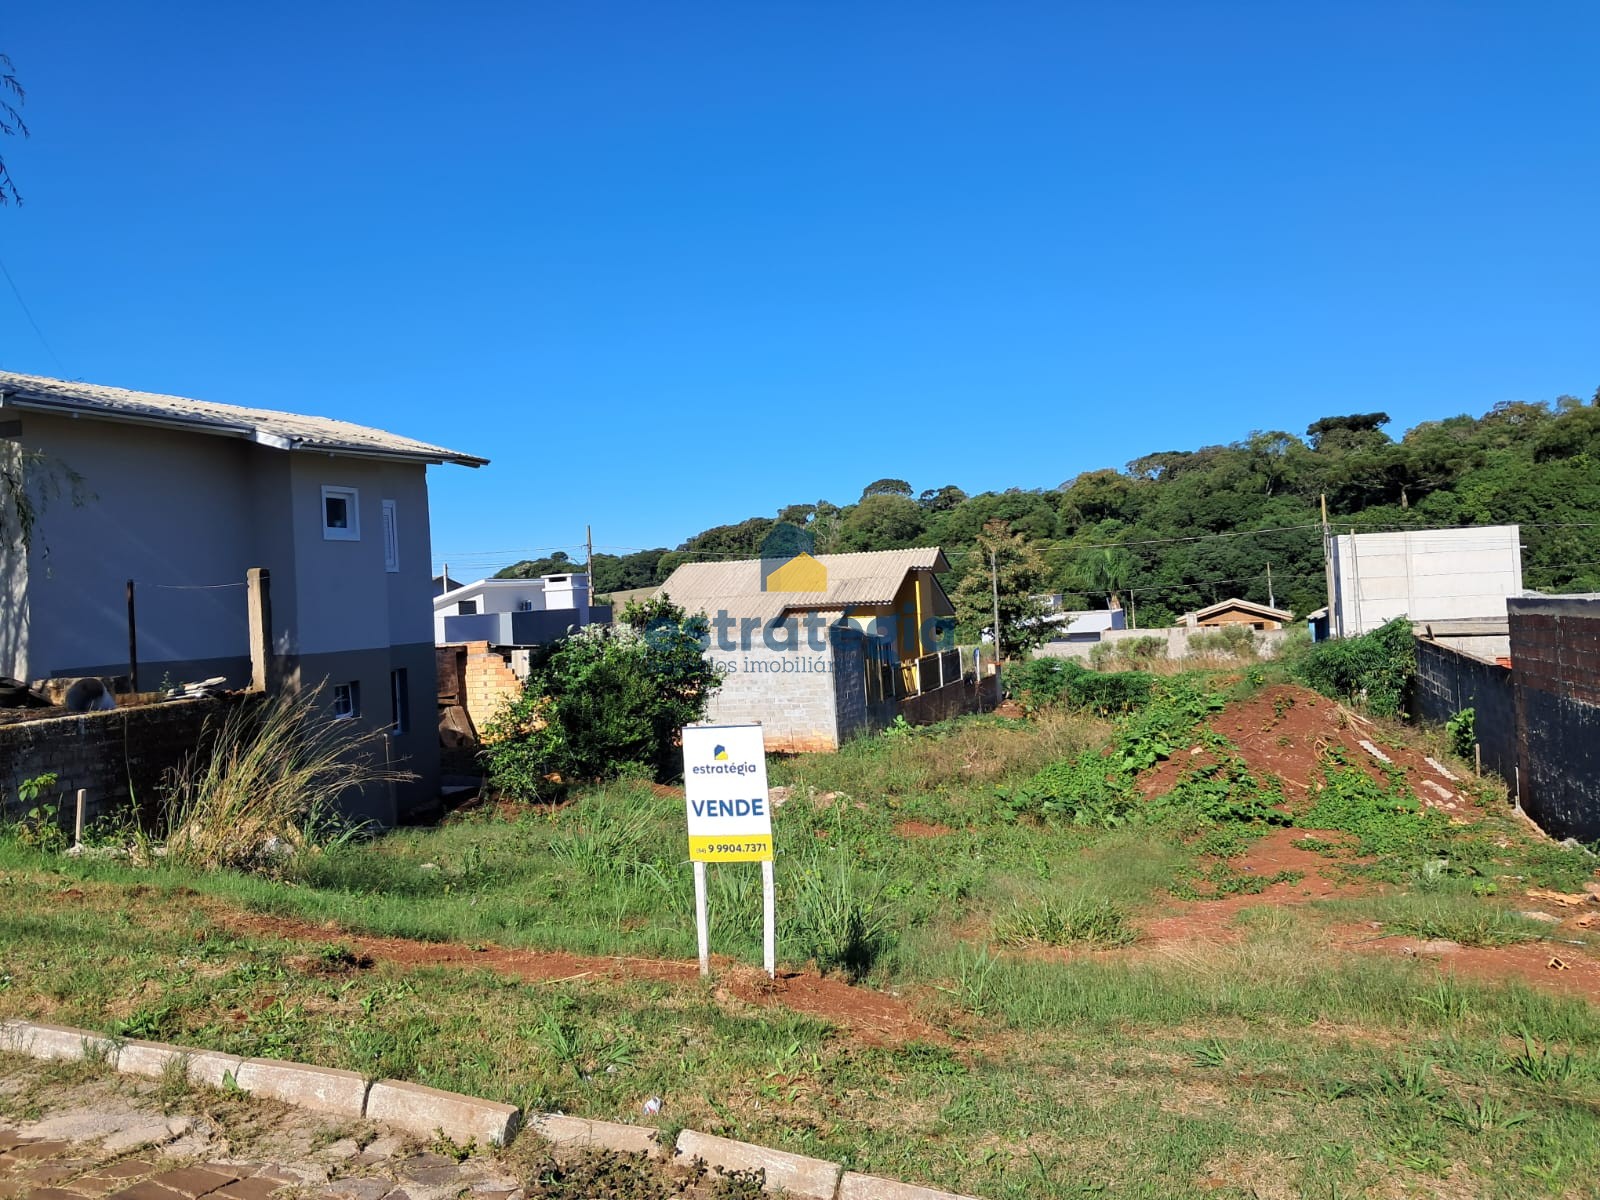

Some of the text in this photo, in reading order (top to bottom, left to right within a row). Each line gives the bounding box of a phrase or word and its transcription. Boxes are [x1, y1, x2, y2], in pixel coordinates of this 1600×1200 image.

[692, 762, 757, 776] estratégia
[691, 798, 764, 817] VENDE
[716, 843, 767, 853] 9904.7371
